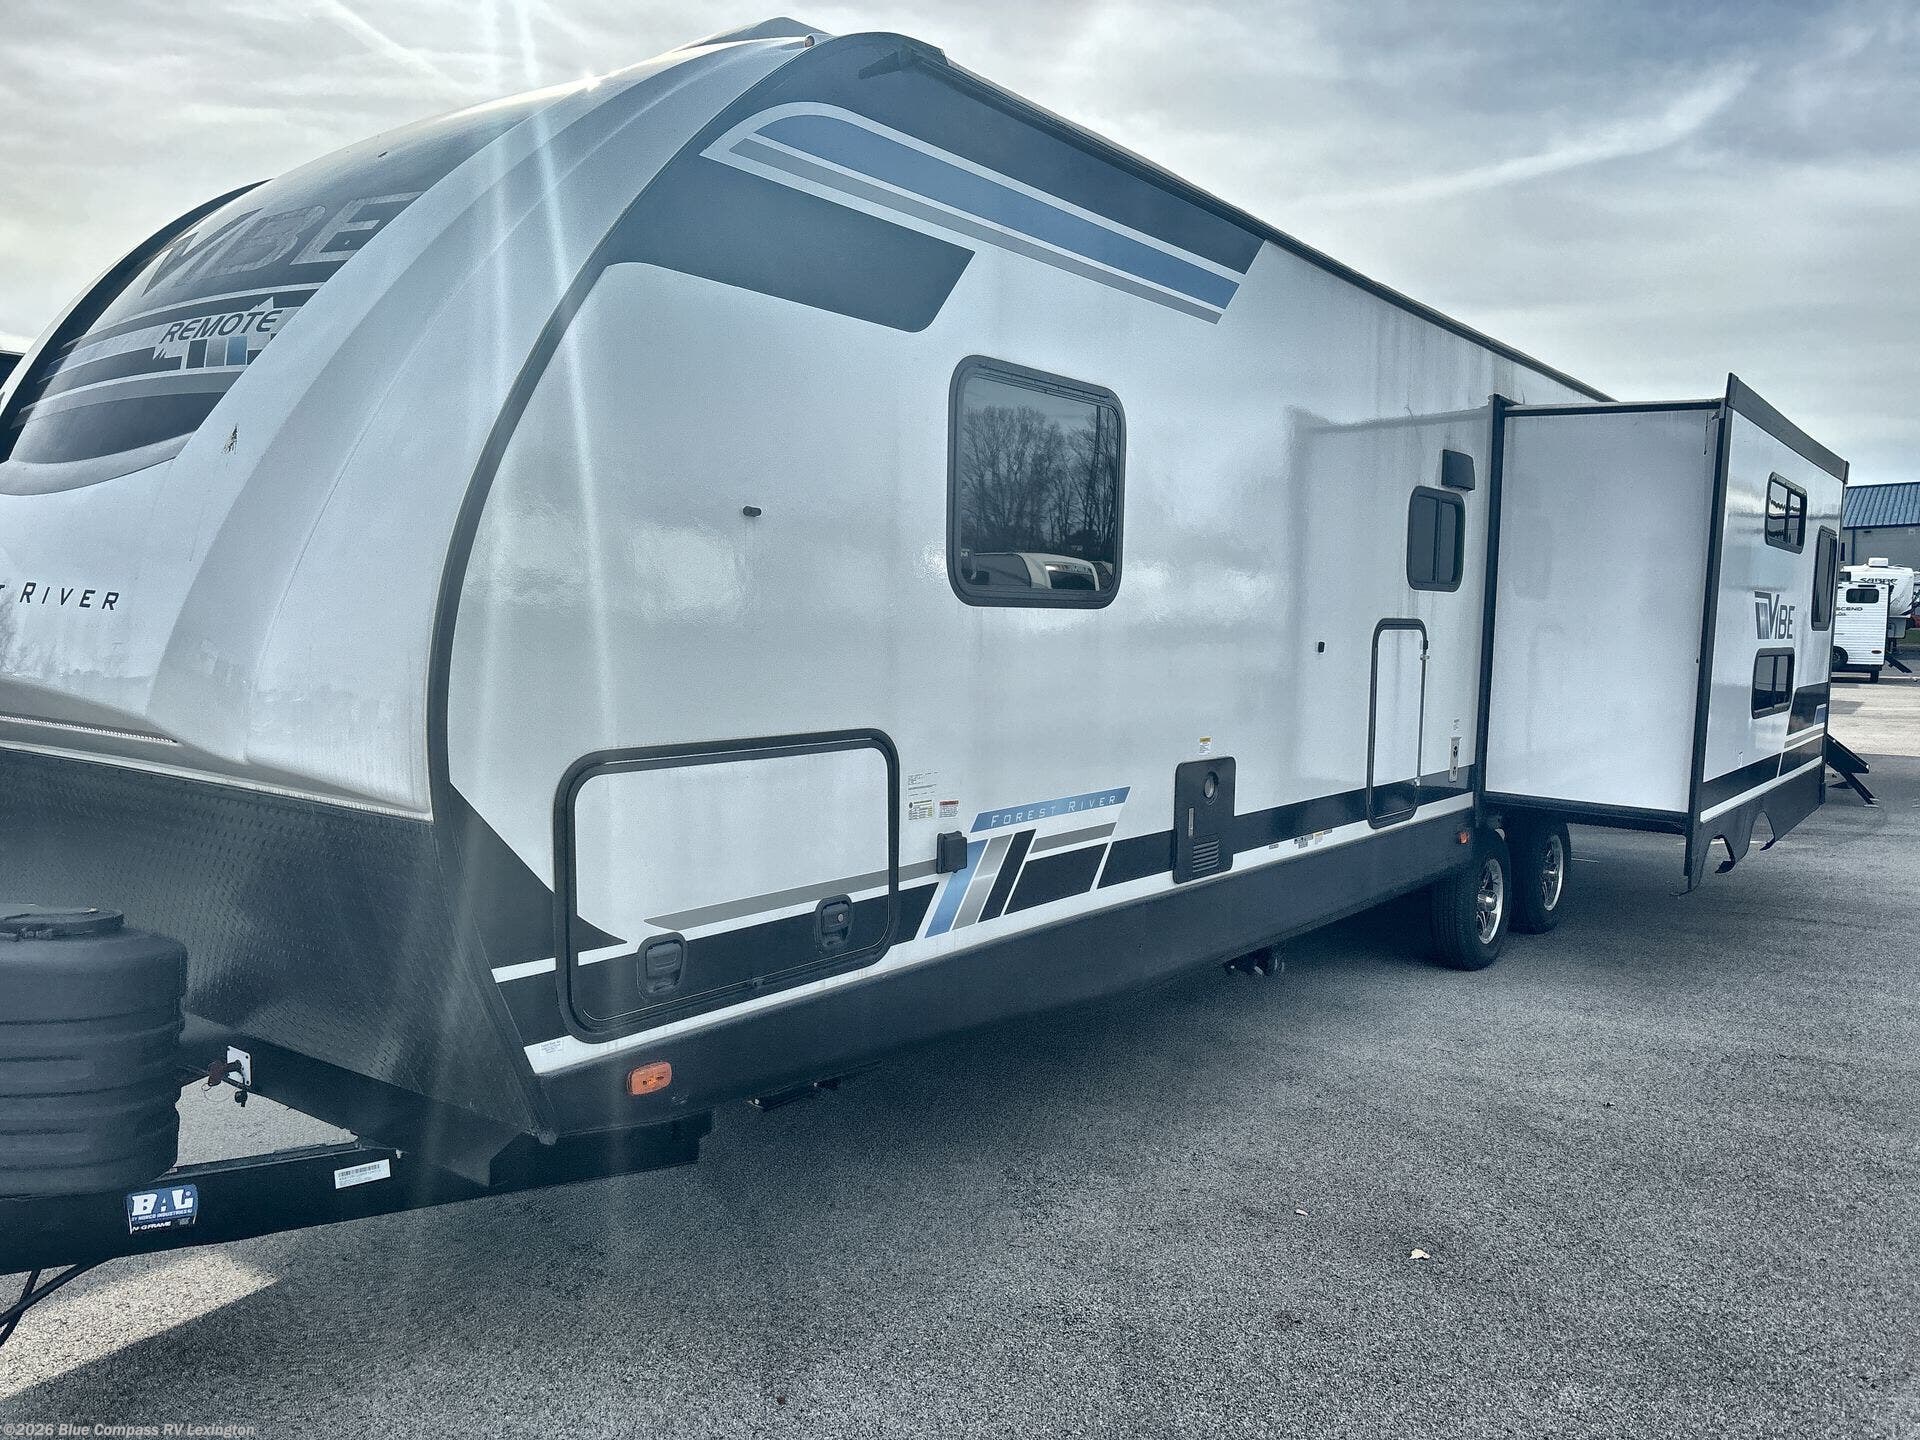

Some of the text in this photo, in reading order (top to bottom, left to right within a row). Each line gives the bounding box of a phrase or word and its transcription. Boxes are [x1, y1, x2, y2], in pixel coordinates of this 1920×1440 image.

[160, 308, 283, 344] REMOTE
[990, 795, 1116, 828] FOREST RIVER
[131, 1189, 194, 1217] BAL
